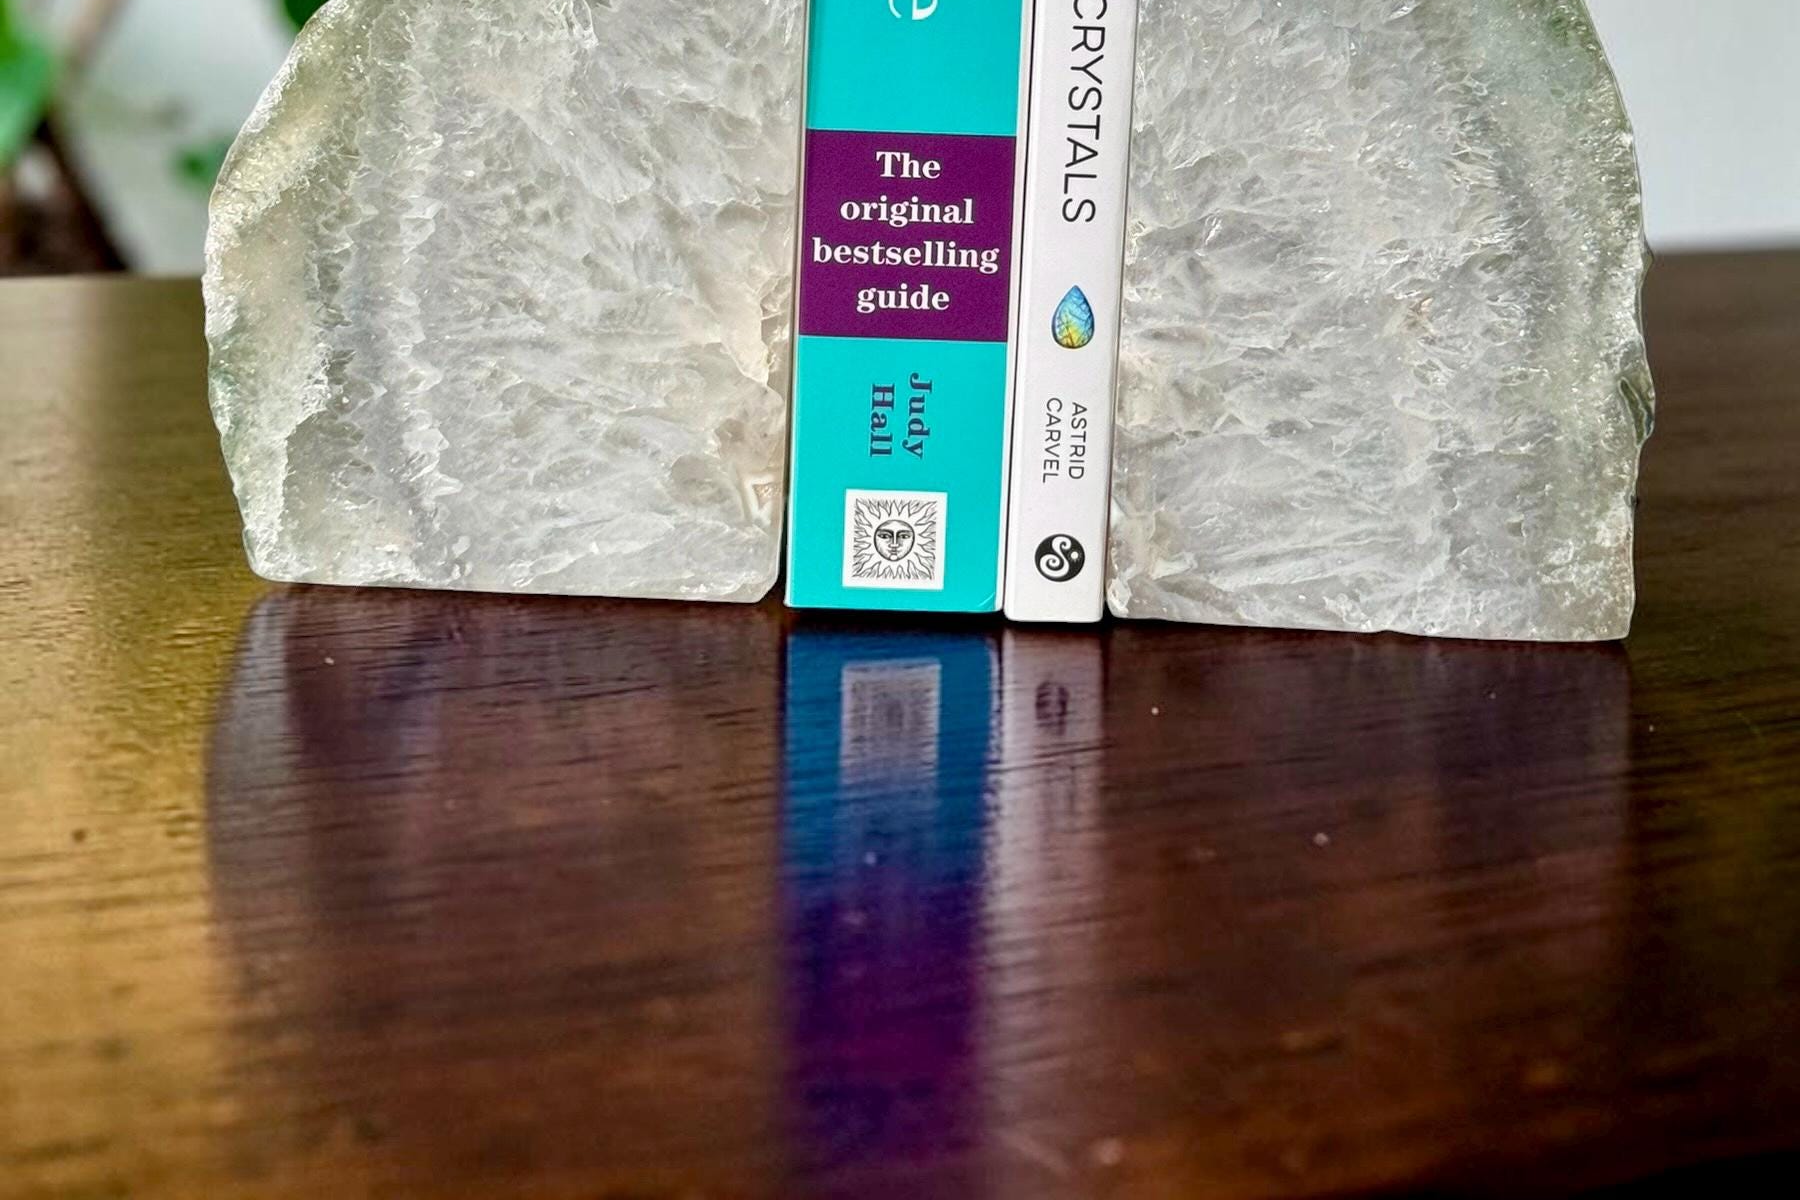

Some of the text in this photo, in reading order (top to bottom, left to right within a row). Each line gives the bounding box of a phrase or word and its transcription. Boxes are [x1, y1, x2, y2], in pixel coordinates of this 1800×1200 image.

[875, 150, 941, 180] The
[839, 196, 974, 229] original
[811, 237, 1000, 274] bestselling
[855, 283, 951, 314] guide
[869, 383, 896, 458] Hall
[902, 372, 933, 460] Judy
[1042, 397, 1063, 484] CARVEL
[1068, 401, 1088, 480] ASTRID
